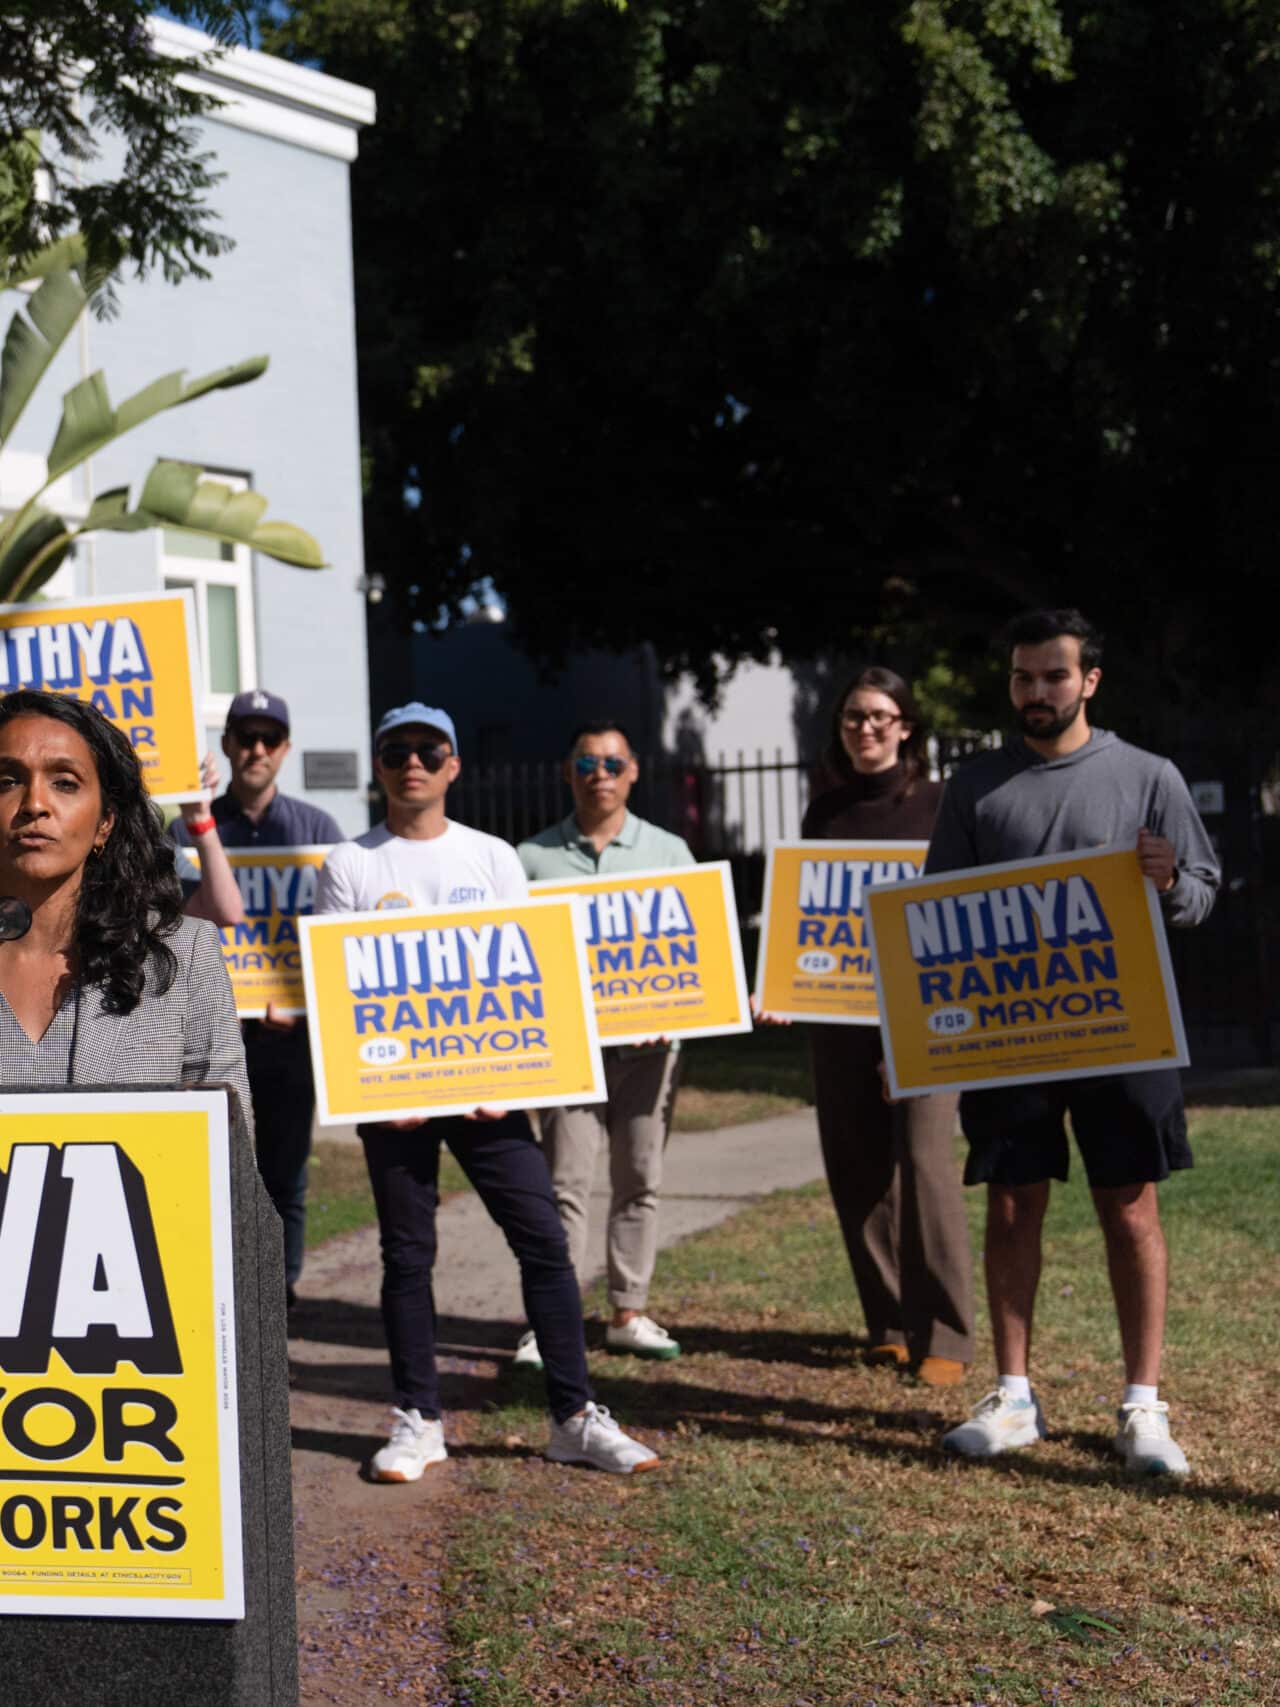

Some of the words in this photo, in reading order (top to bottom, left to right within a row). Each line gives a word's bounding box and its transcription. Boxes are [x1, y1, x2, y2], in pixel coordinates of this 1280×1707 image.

[230, 864, 319, 916] HYA
[582, 886, 696, 945] THYA
[904, 875, 1114, 967] NITHYA
[223, 951, 301, 970] MAYO
[342, 922, 542, 998] NITHYA
[589, 941, 697, 975] MAN
[918, 946, 1117, 1004] RAMAN
[353, 989, 545, 1035] RAMAN
[934, 1013, 966, 1030] FOR
[978, 988, 1124, 1028] MAYOR
[366, 1045, 398, 1059] FOR
[410, 1028, 549, 1060] MAYOR
